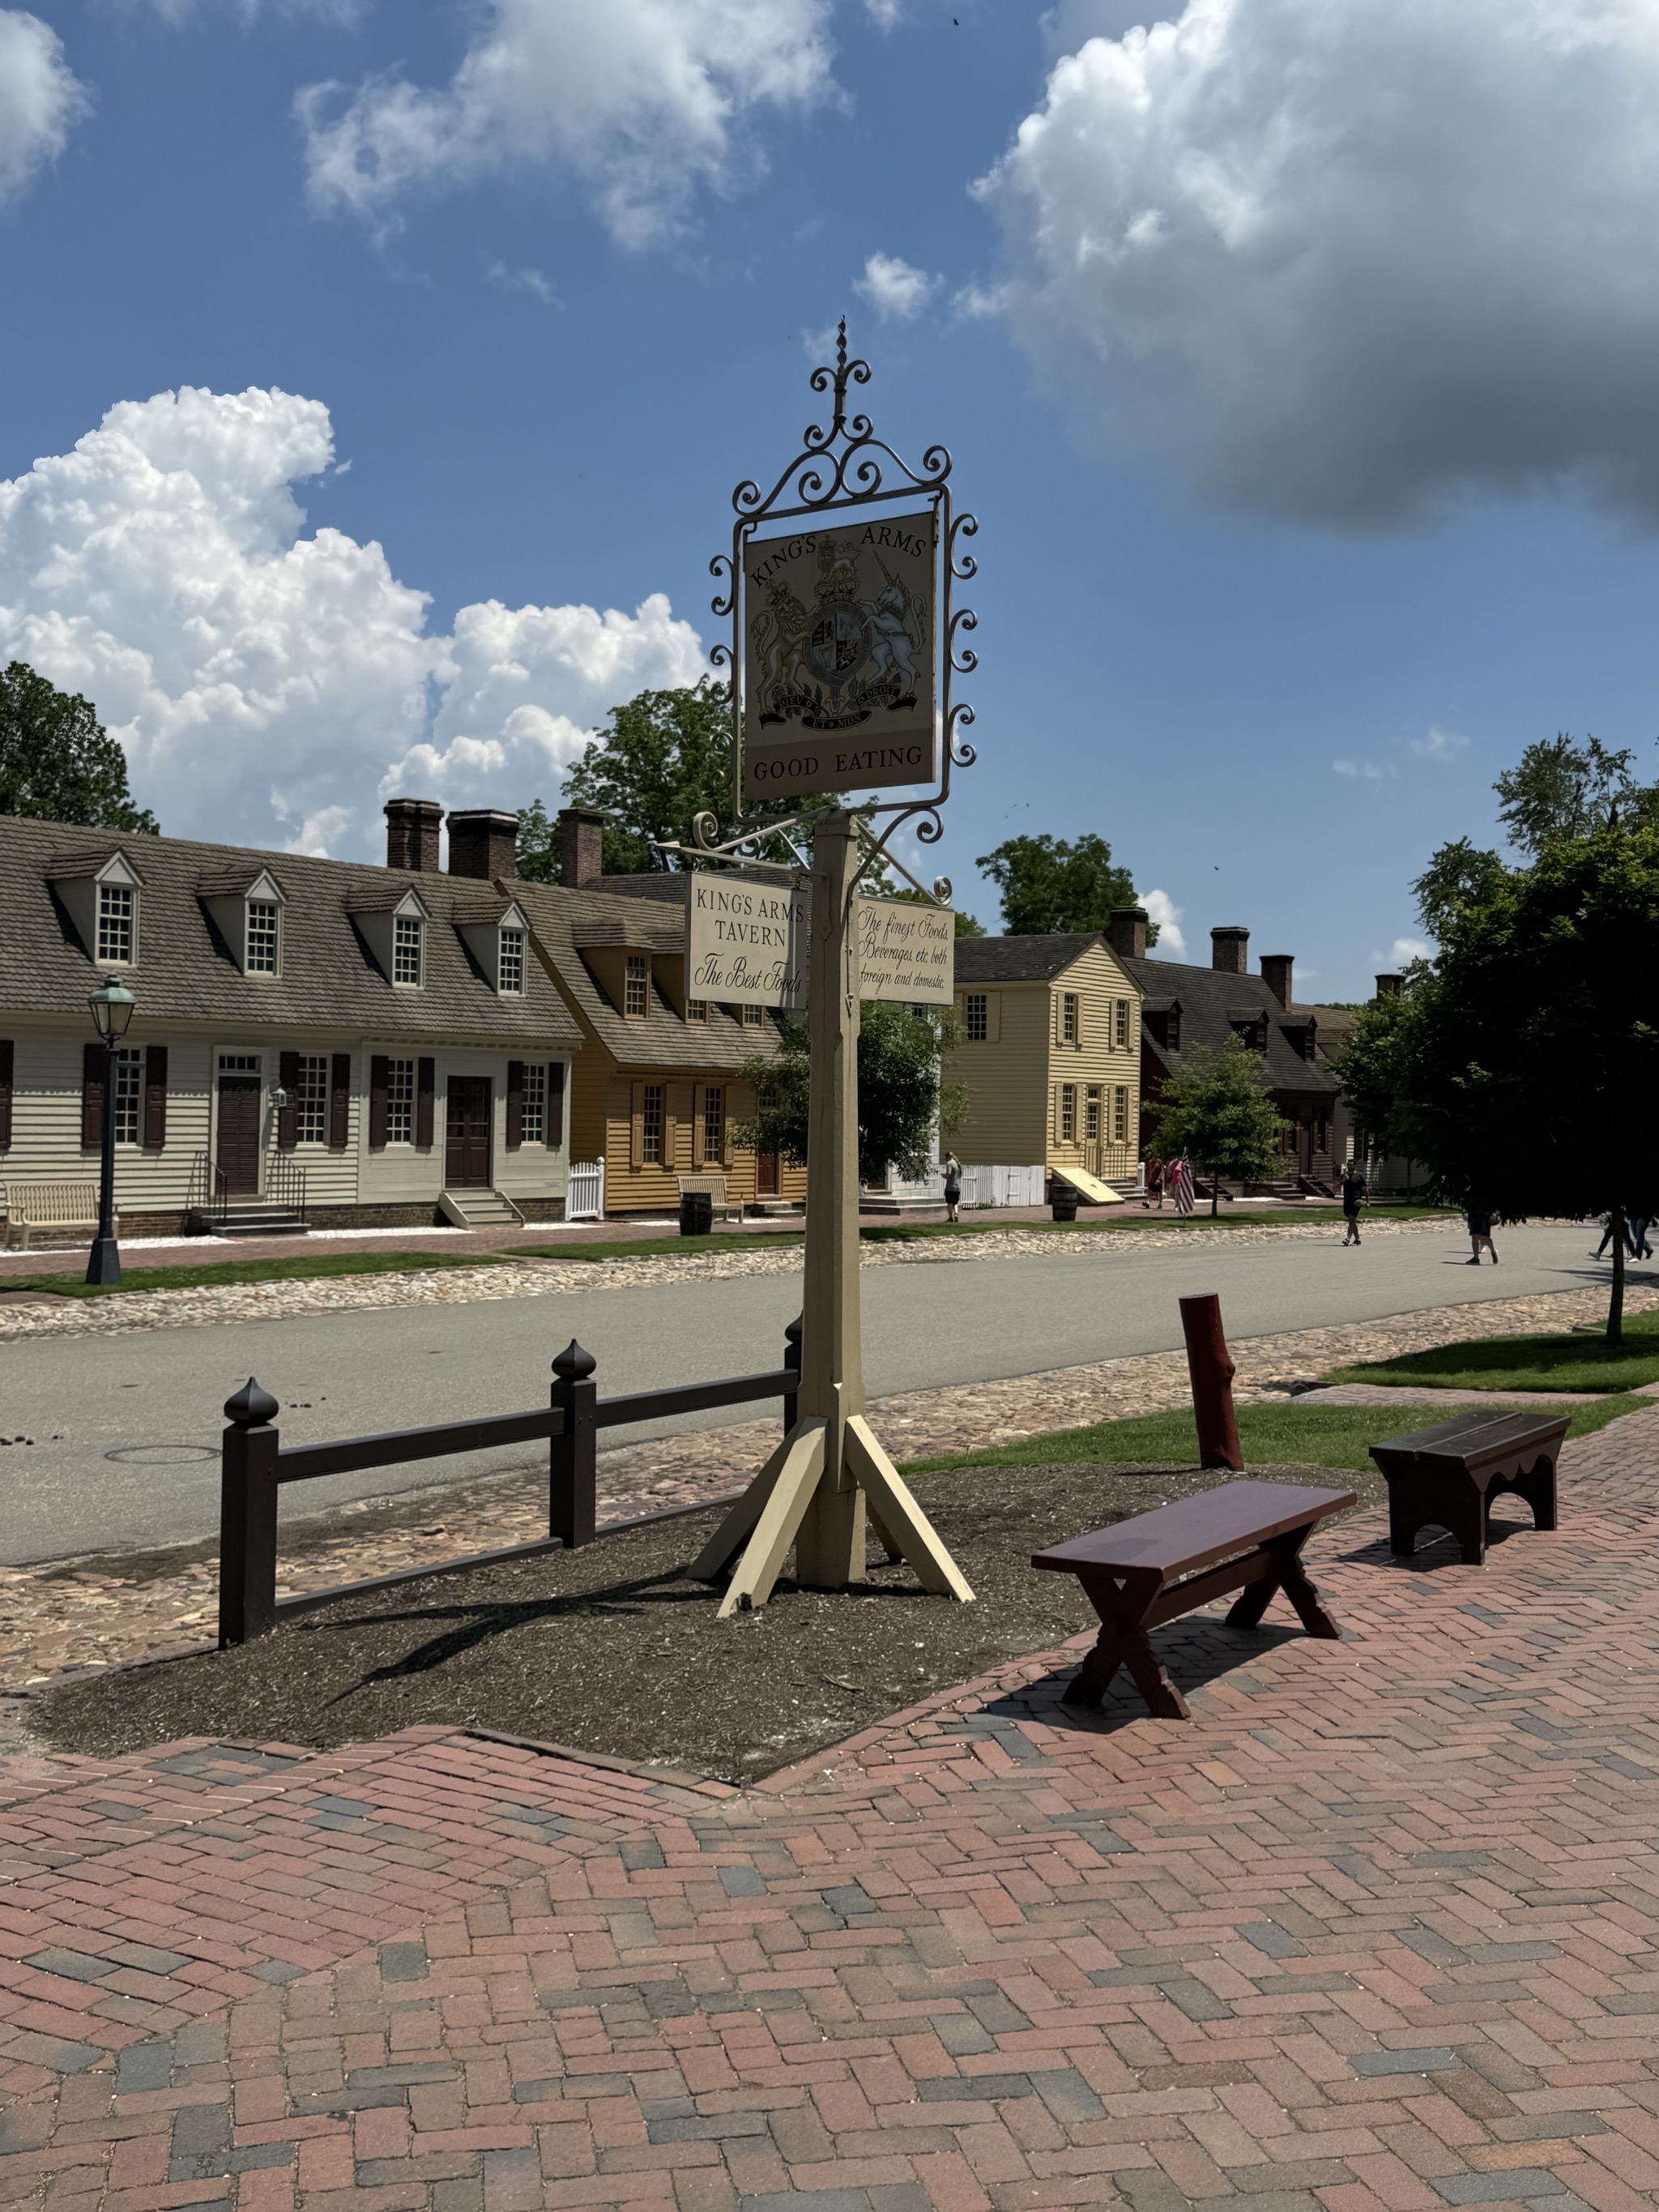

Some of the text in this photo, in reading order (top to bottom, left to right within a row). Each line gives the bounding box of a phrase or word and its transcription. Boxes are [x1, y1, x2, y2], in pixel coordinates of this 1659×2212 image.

[750, 526, 927, 587] KING'S ARMS
[866, 685, 898, 699] DROIT
[812, 714, 862, 728] ET MON
[754, 746, 922, 780] GOOD EATING
[697, 889, 804, 923] KING'S ARMS
[858, 906, 882, 932] The
[714, 920, 786, 947] TAVERN
[931, 946, 948, 966] both
[694, 953, 802, 993] The Best Foods
[859, 963, 893, 995] foreign
[894, 971, 914, 986] and
